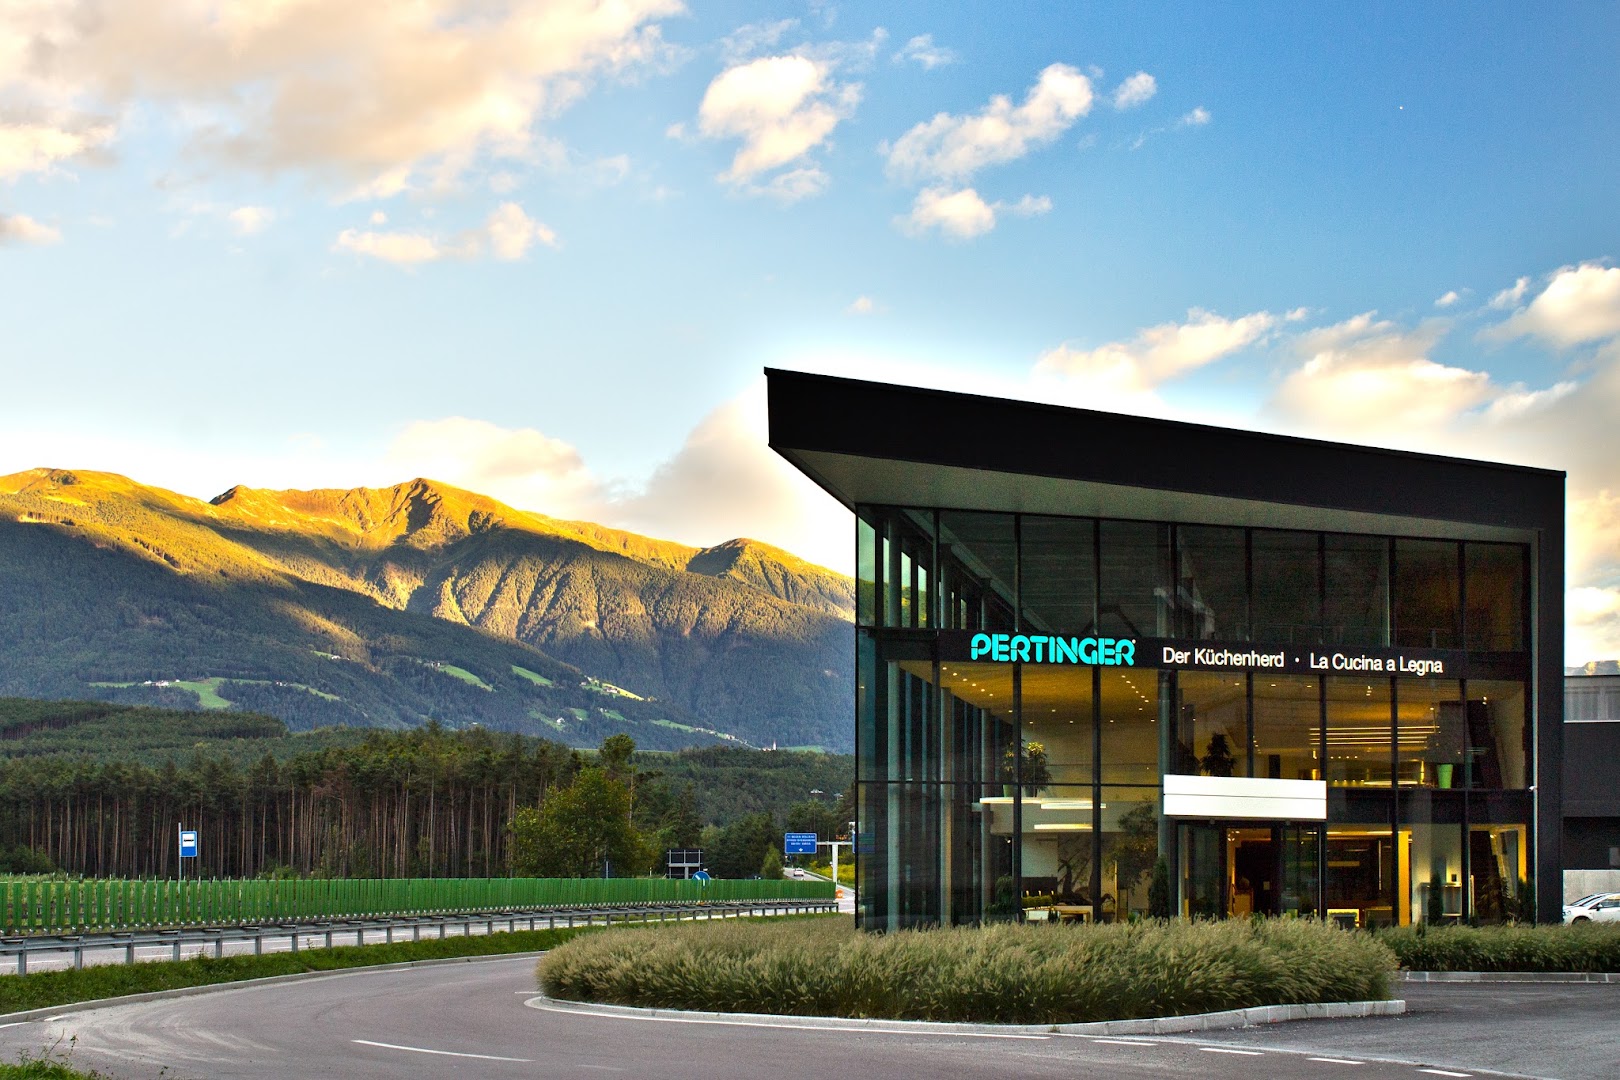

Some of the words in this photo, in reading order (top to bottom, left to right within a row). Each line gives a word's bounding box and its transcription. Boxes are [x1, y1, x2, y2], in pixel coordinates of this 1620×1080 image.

[971, 634, 1135, 666] PERTINGER
[1162, 646, 1190, 664] Der
[1195, 647, 1285, 668] Küchenherd
[1310, 652, 1329, 669] La
[1332, 653, 1383, 671] Cucina
[1386, 658, 1397, 672] a
[1399, 655, 1444, 677] Legna
